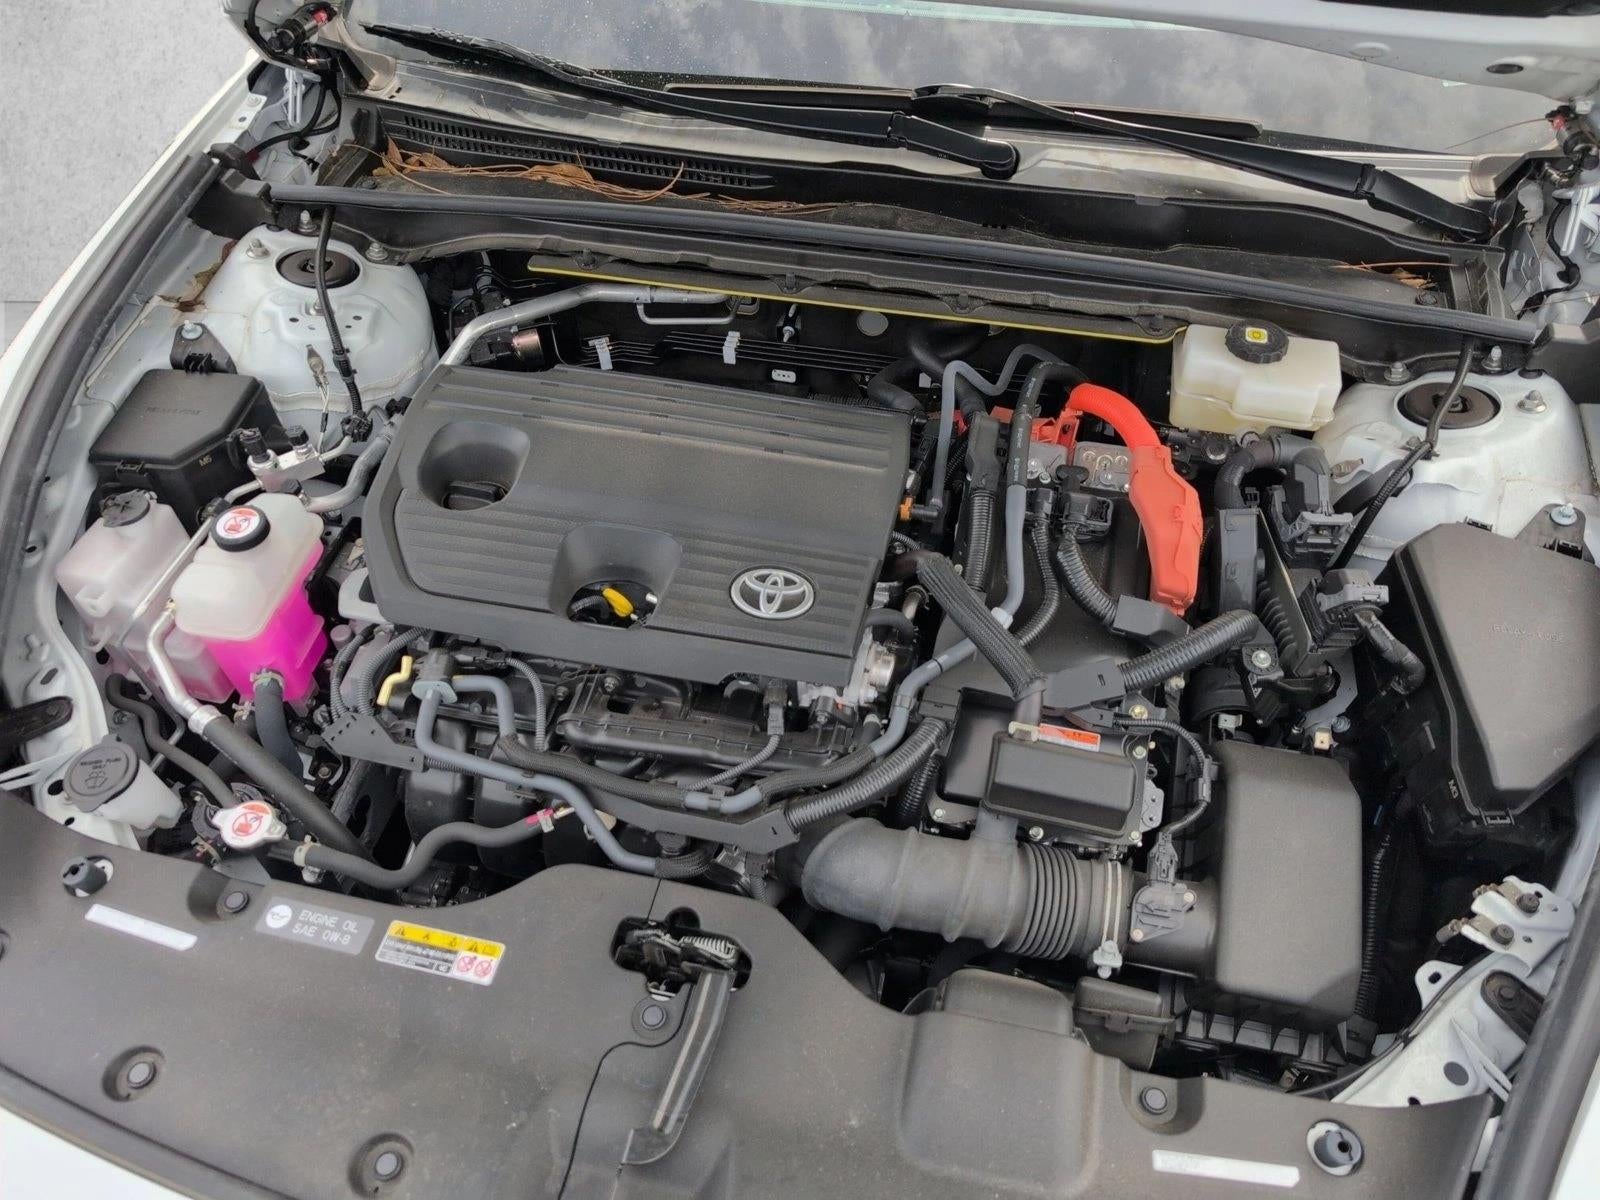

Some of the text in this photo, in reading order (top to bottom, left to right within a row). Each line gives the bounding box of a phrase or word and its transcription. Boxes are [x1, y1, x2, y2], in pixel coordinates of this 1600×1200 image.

[292, 922, 318, 937] SAE
[299, 909, 358, 933] ENGINE OIL
